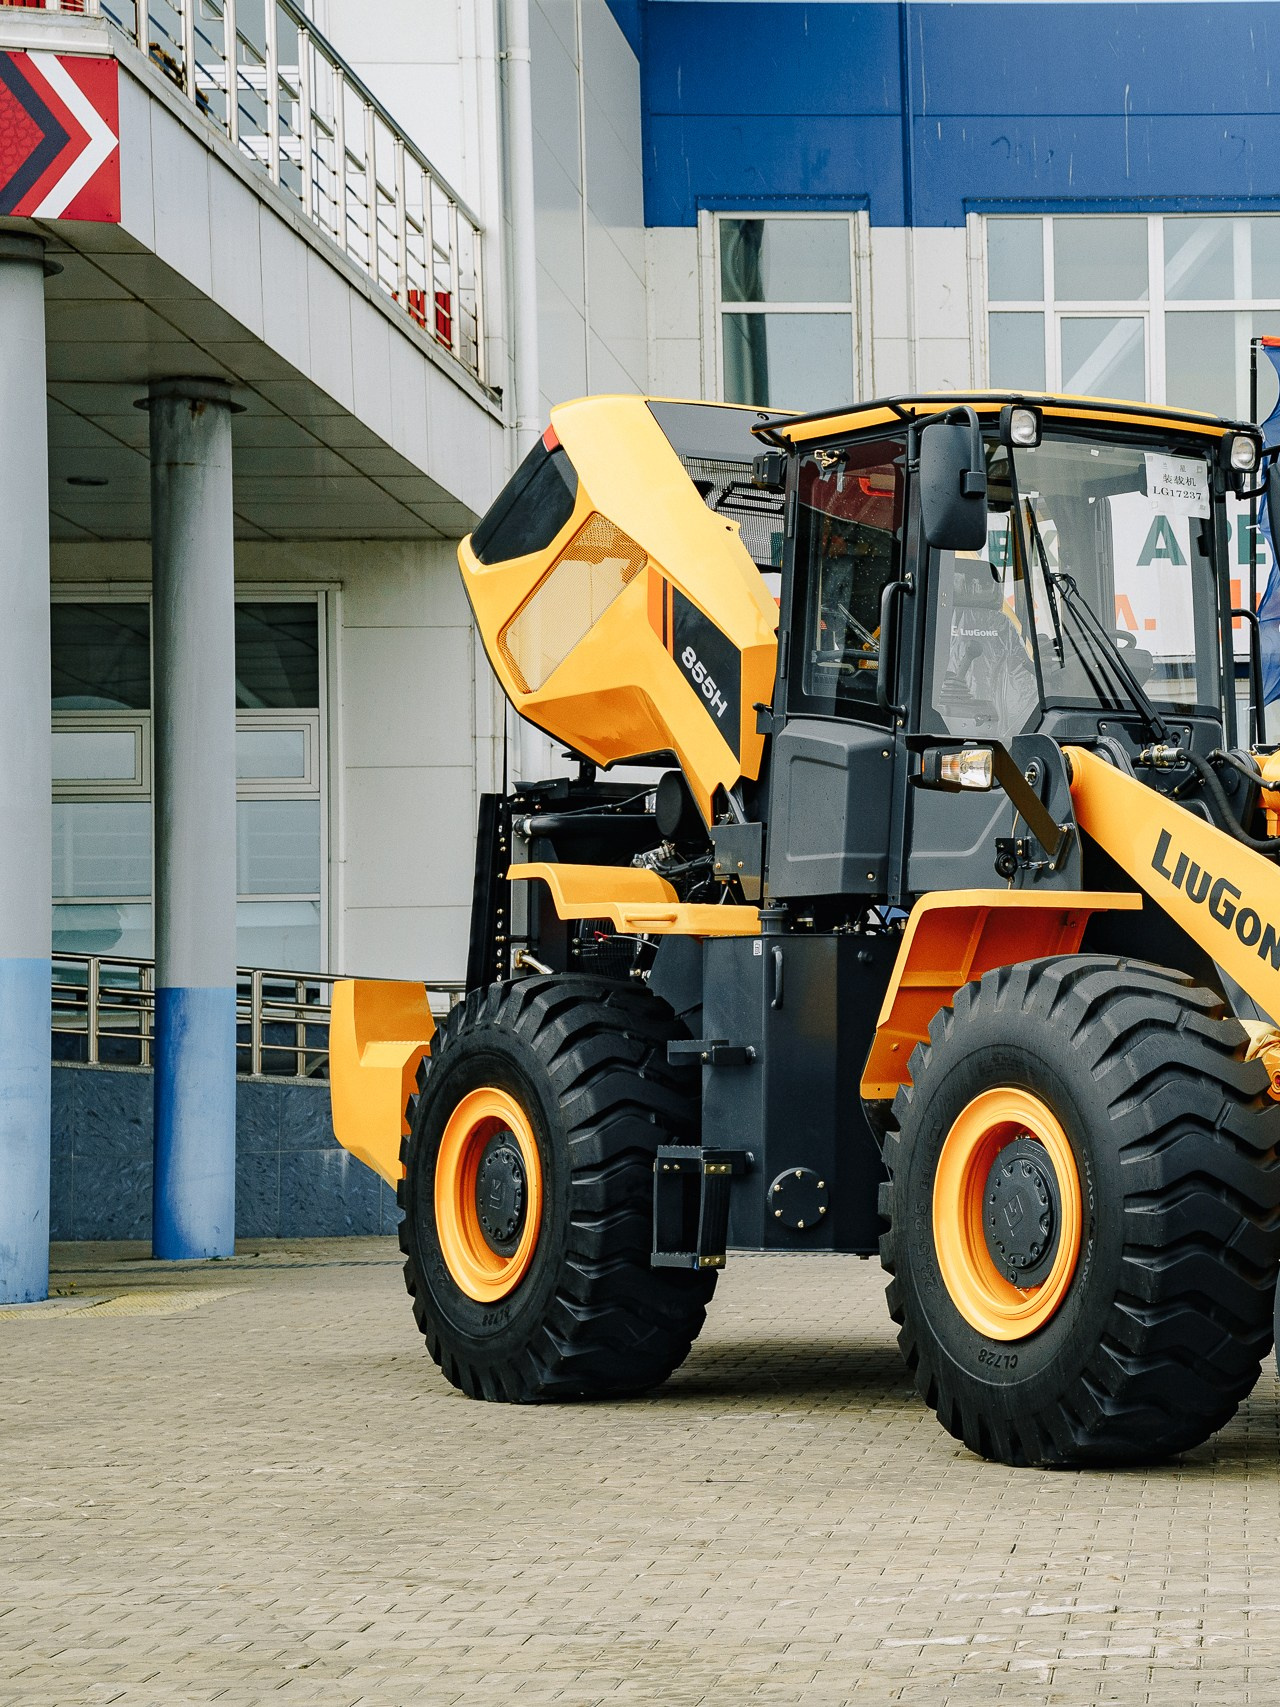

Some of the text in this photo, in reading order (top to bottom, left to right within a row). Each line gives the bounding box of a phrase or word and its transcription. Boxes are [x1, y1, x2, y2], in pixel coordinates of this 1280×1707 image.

[1153, 485, 1202, 500] LG17237
[681, 646, 728, 718] 855H
[978, 1347, 1019, 1370] CL728
